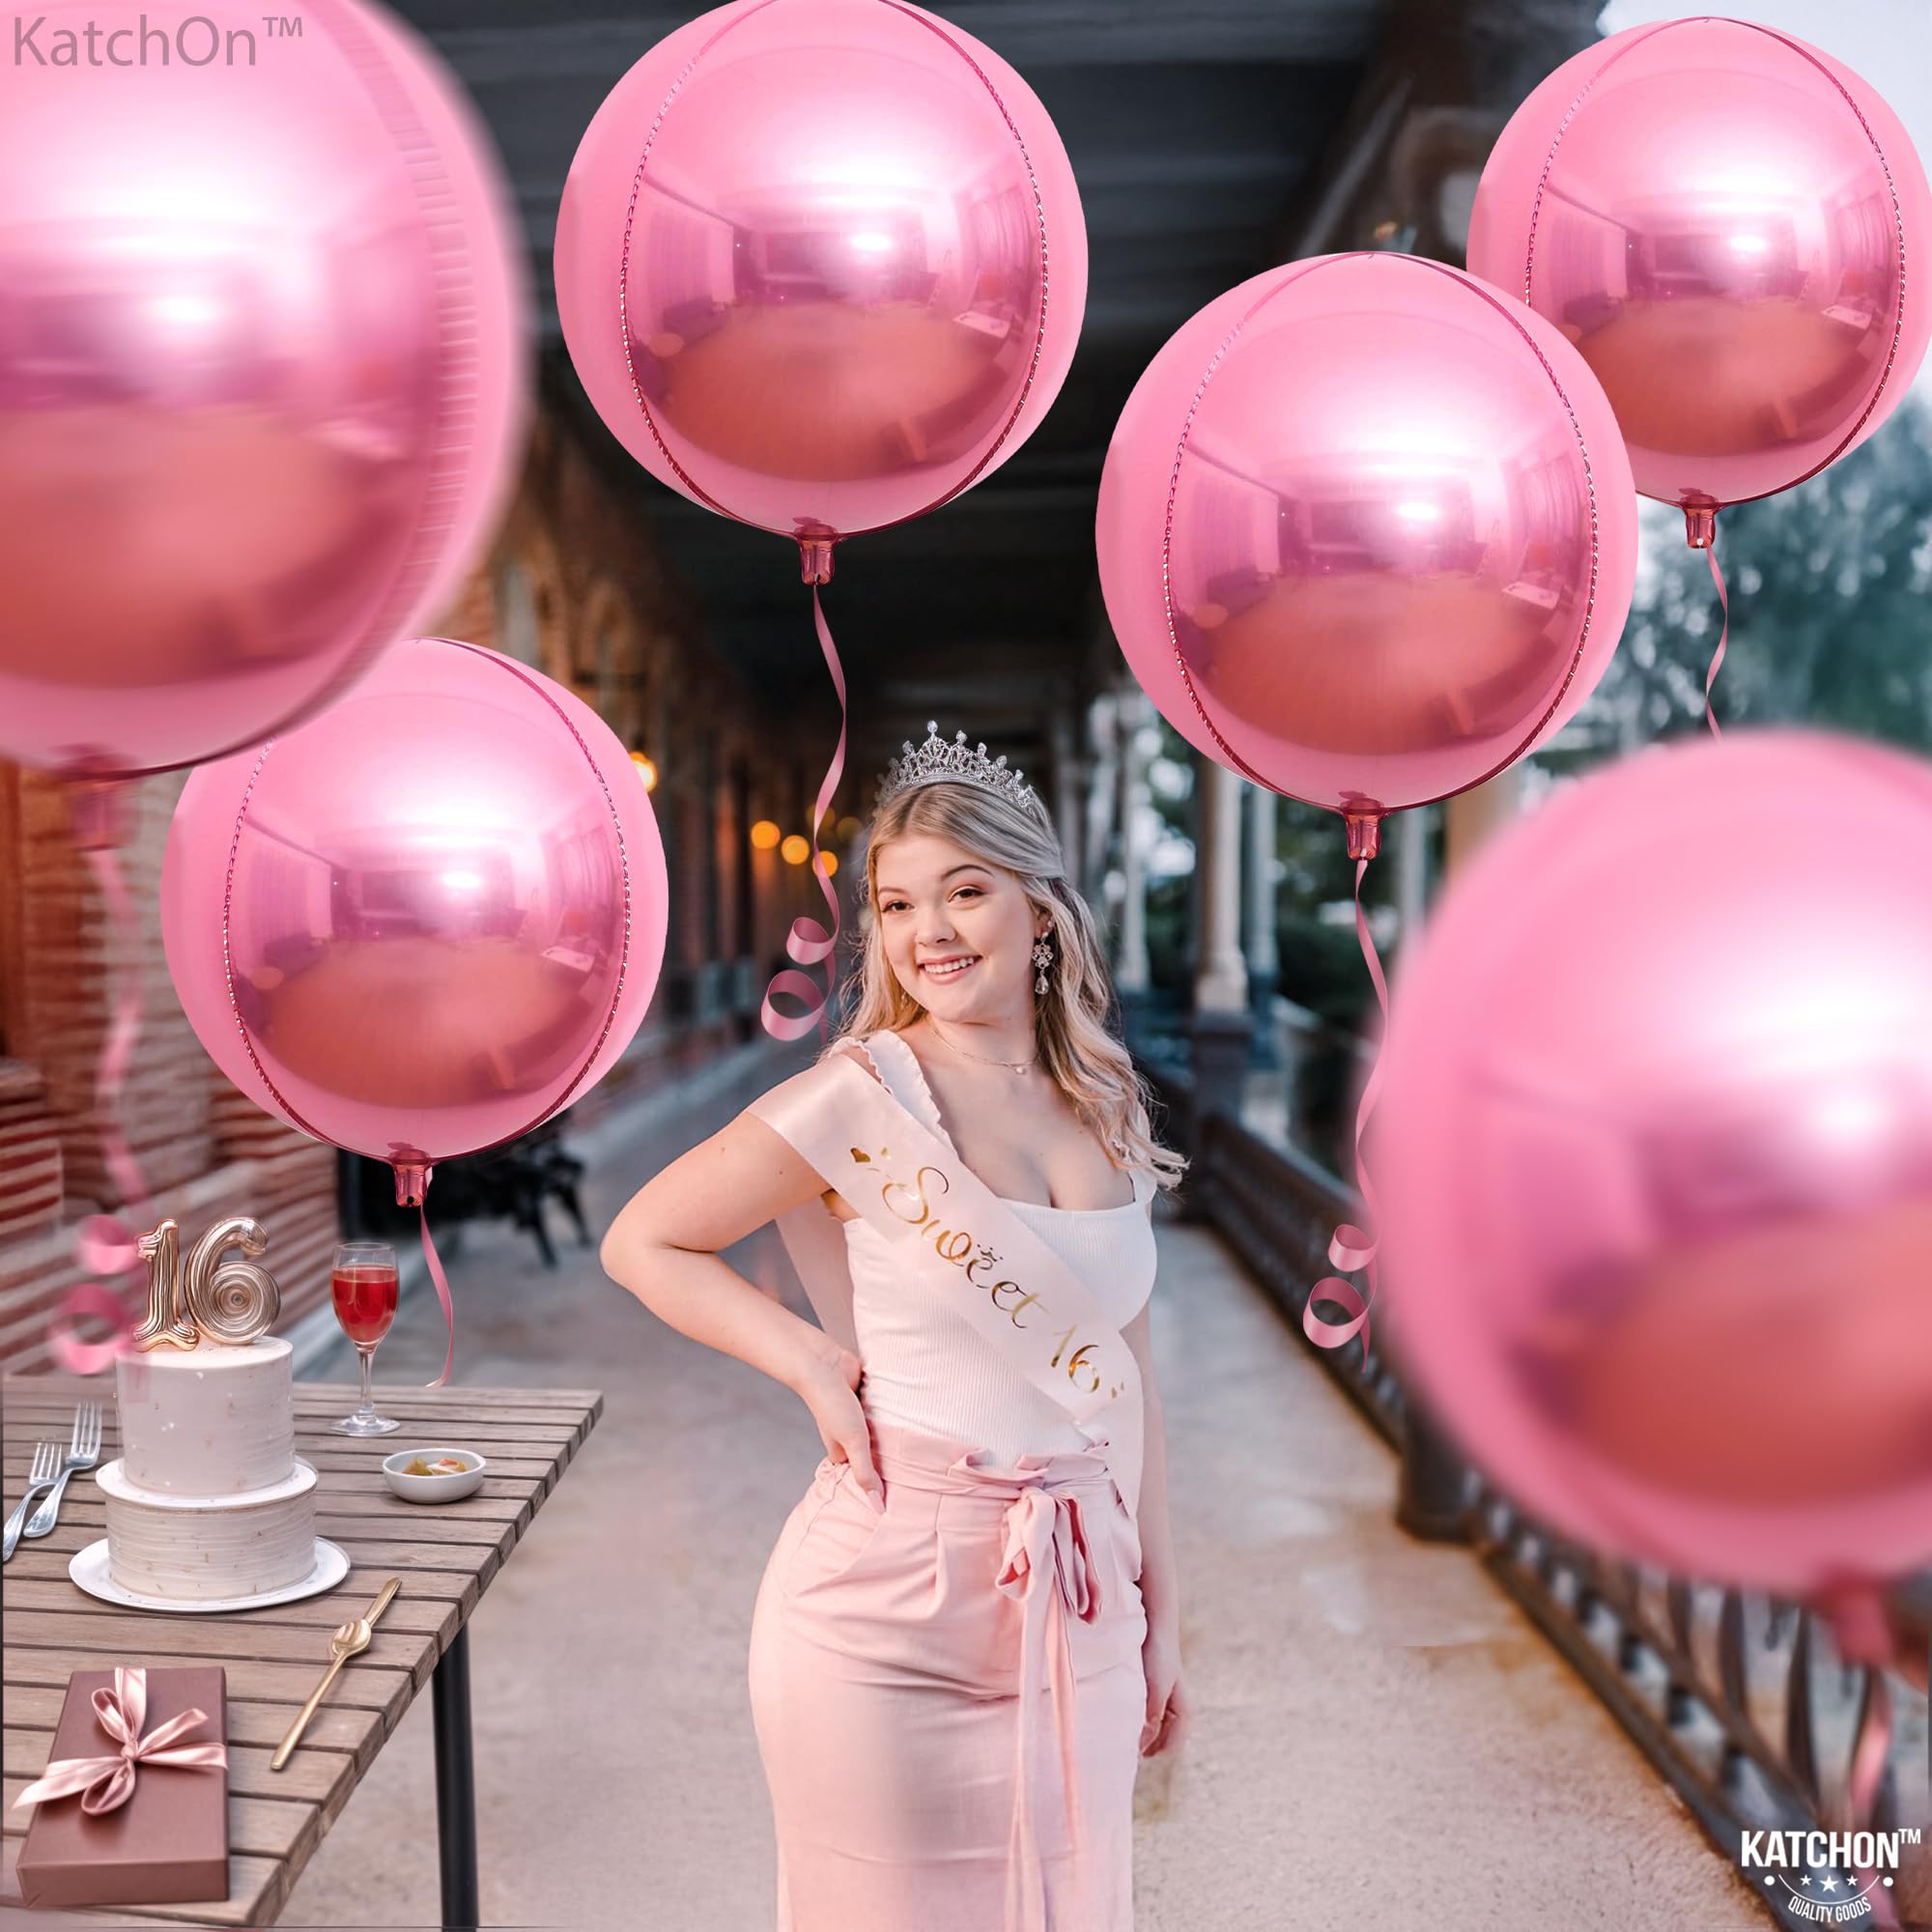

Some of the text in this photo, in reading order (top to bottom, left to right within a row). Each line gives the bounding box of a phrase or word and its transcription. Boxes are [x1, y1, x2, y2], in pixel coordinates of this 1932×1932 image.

[131, 1216, 281, 1352] 16
[881, 1166, 1100, 1394] Sweet 16
